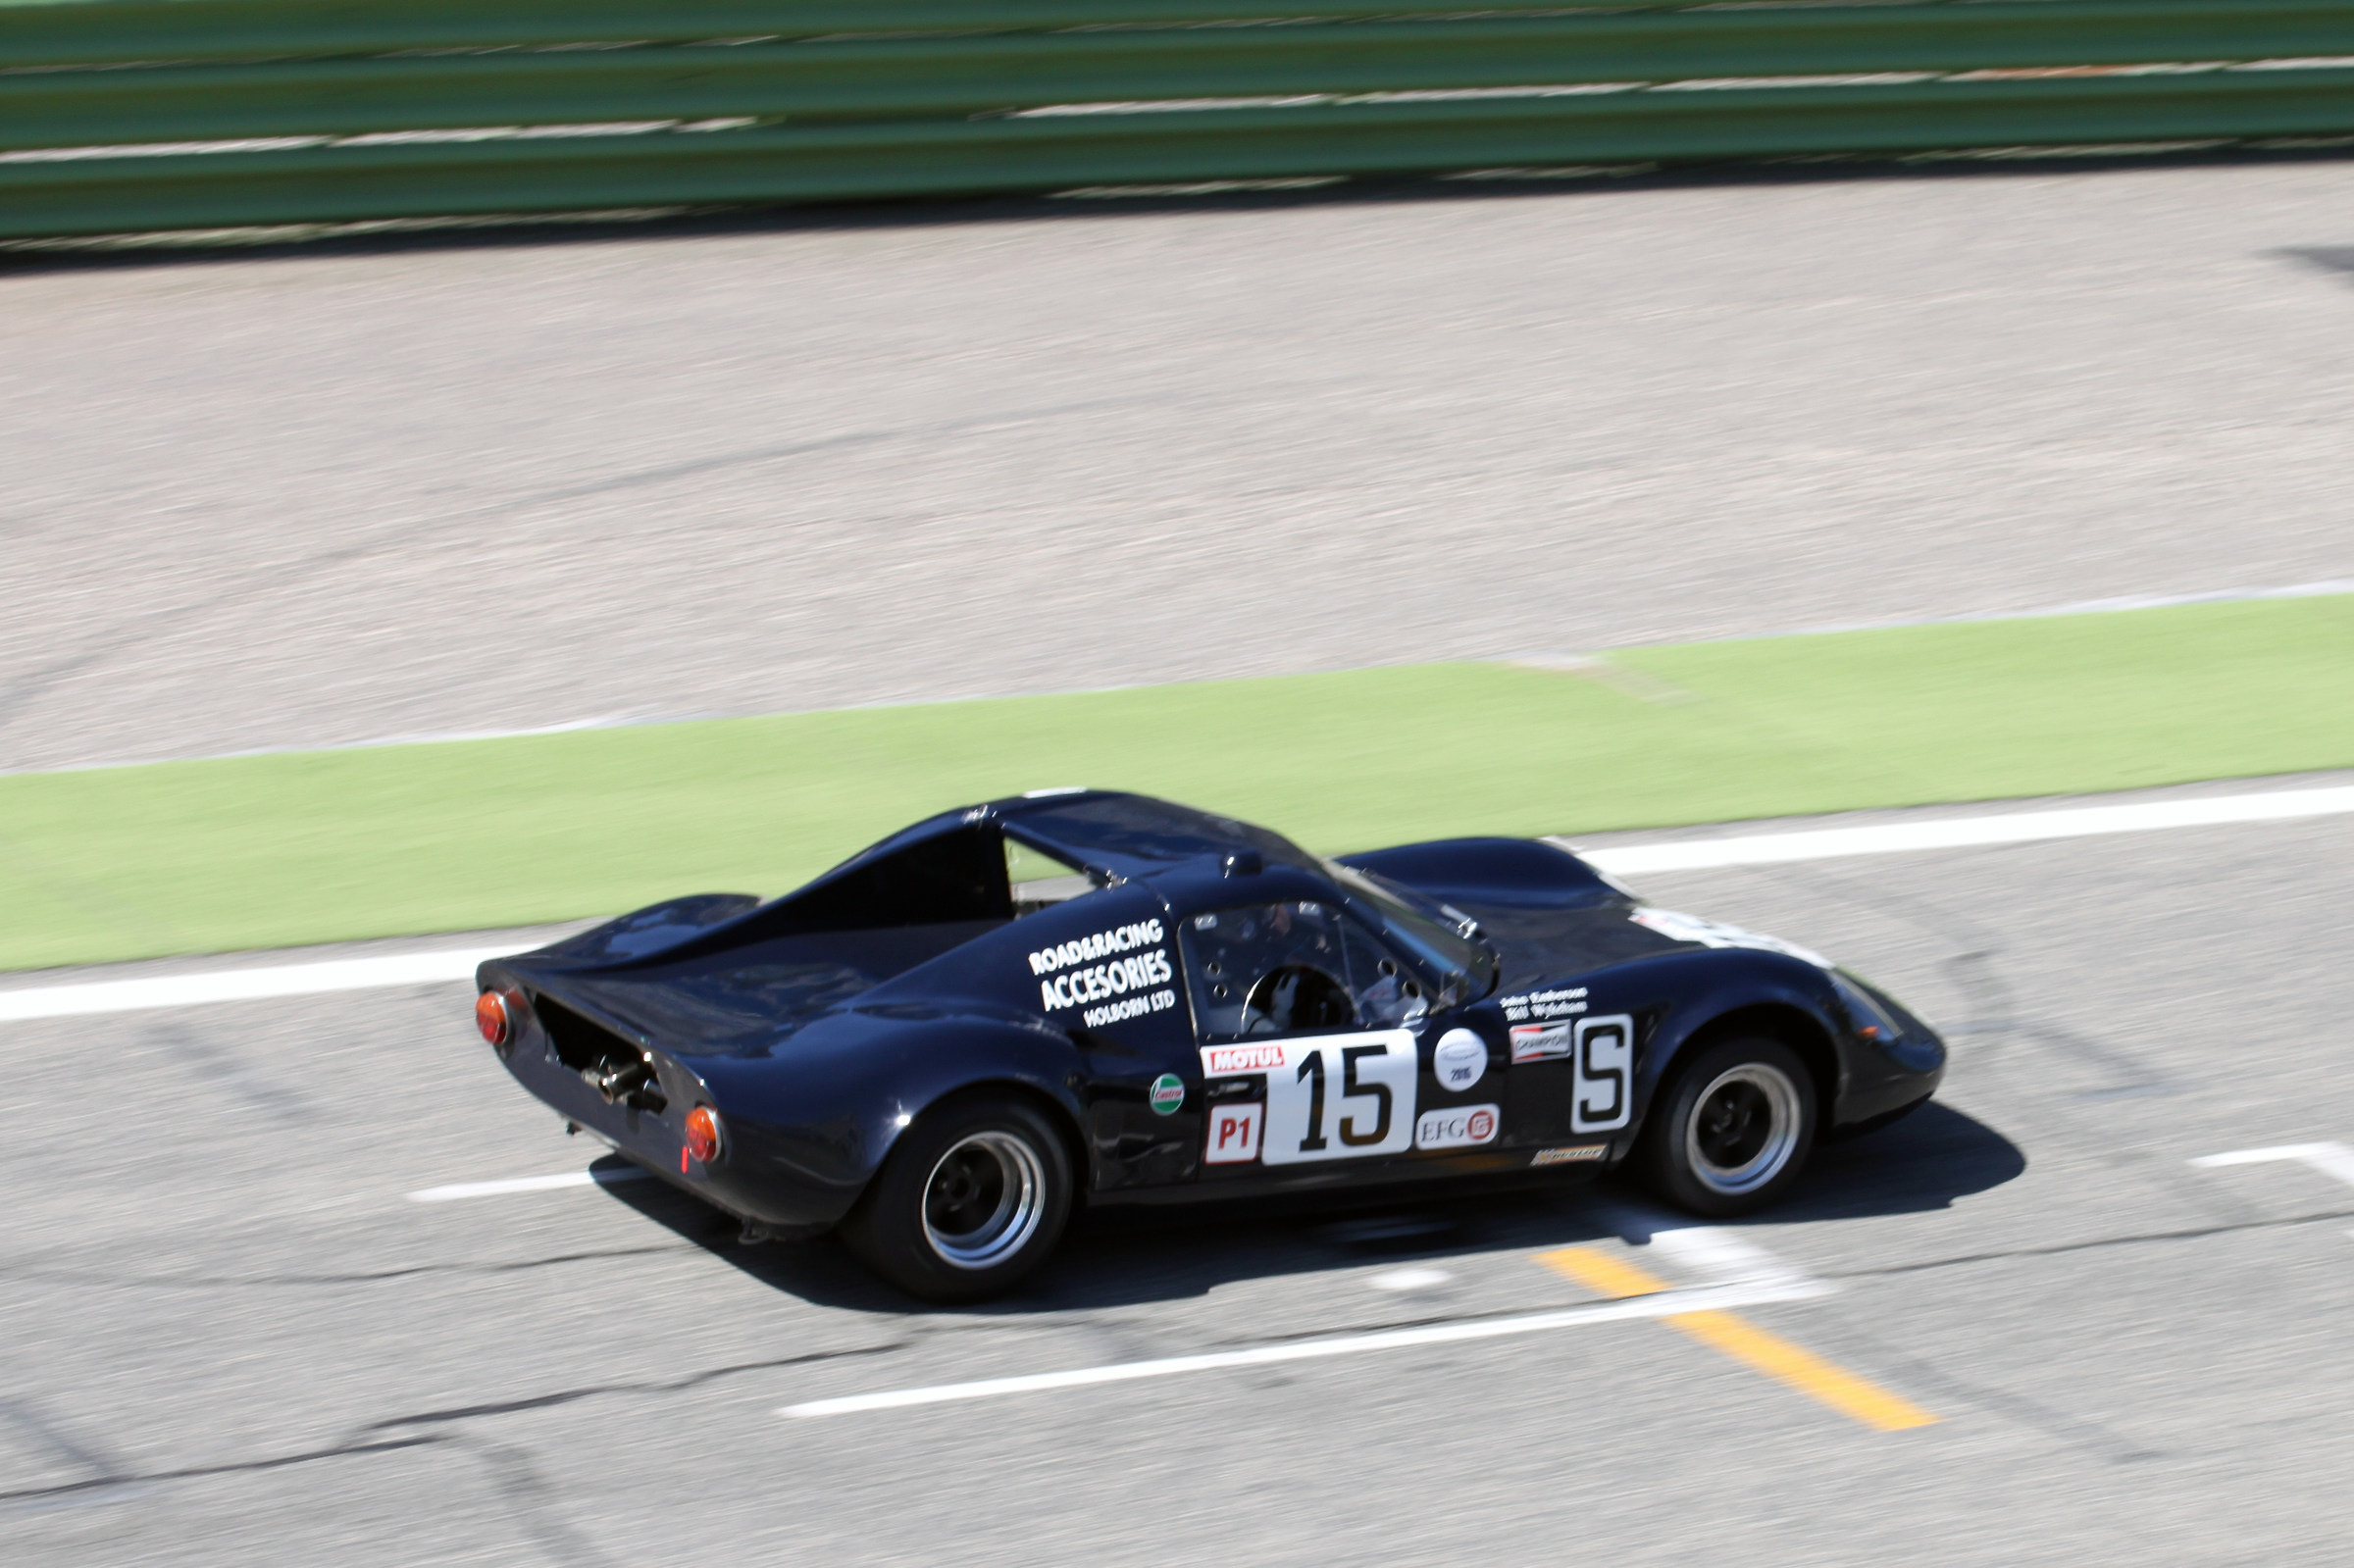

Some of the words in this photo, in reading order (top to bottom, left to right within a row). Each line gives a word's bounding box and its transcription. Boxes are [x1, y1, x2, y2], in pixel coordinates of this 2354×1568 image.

[1029, 918, 1164, 976] ROAD&RACING
[1041, 948, 1173, 1012] ACCESORIES
[1083, 994, 1151, 1028] HOLBORN
[1151, 988, 1175, 1013] LTD
[1212, 1048, 1284, 1071] MOTUL
[1580, 1024, 1625, 1123] S
[1298, 1043, 1394, 1152] 15
[1218, 1116, 1251, 1150] P1
[1421, 1117, 1466, 1142] EFG
